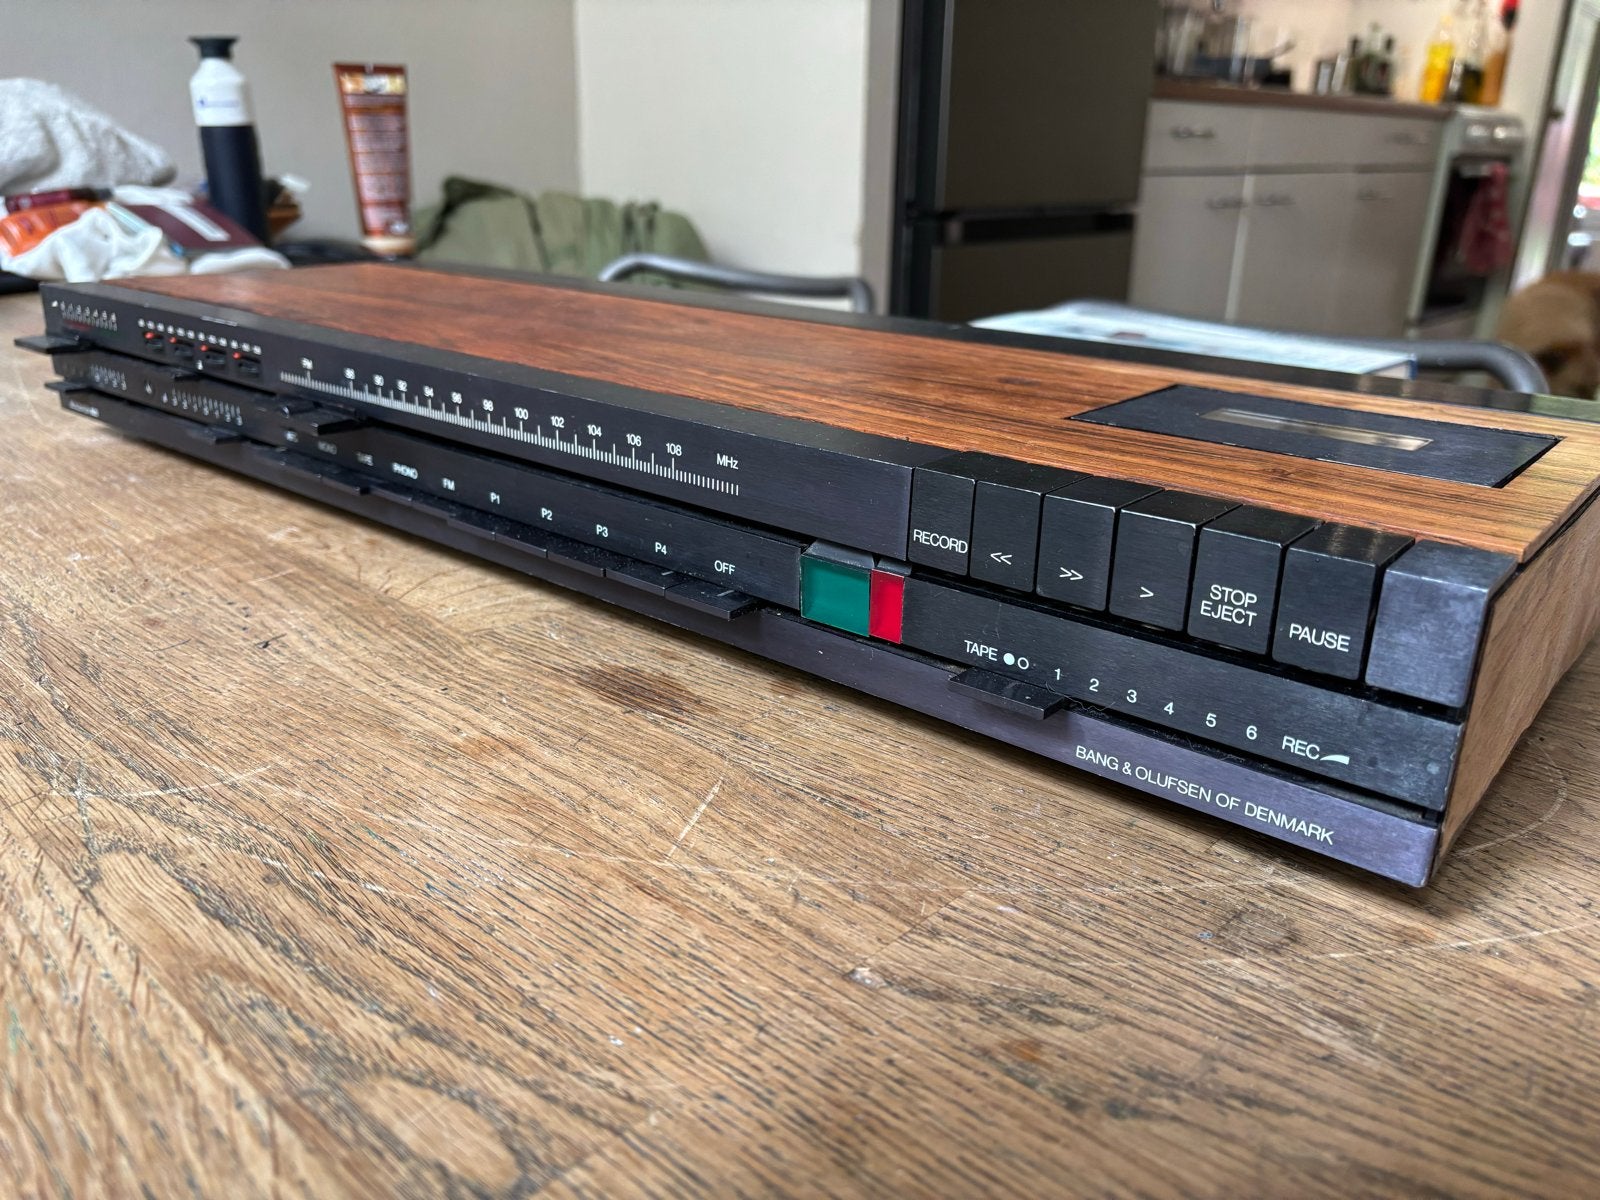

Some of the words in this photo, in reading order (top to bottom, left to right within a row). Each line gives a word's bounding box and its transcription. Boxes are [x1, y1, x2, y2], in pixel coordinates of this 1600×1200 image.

[396, 380, 407, 392] 92
[423, 385, 434, 398] 94
[451, 391, 462, 404] 96
[482, 399, 494, 412] 98
[514, 407, 529, 421] 100
[550, 416, 565, 429] 102
[587, 424, 602, 438] 104
[626, 433, 642, 447] 106
[665, 443, 682, 457] 108
[716, 453, 739, 470] MHz
[391, 462, 418, 480] PHONO
[442, 477, 456, 491] FM
[490, 492, 501, 504] P1
[541, 507, 553, 521] P2
[596, 524, 609, 538] P3
[913, 529, 968, 554] RECORD
[655, 542, 667, 555] P4
[714, 560, 736, 576] OFF
[1209, 584, 1257, 608] STOP
[1200, 600, 1257, 627] EJECT
[1289, 623, 1350, 653] PAUSE
[964, 639, 998, 661] TAPE
[1054, 668, 1061, 681] 1
[1089, 678, 1100, 692] 2
[1126, 689, 1138, 703] 3
[1163, 702, 1174, 715] 4
[1205, 713, 1217, 727] 5
[1246, 725, 1258, 740] 6
[1281, 735, 1320, 760] REC
[1075, 745, 1119, 771] BANG
[1122, 761, 1132, 776] &
[1135, 766, 1212, 803] OLUFSEN
[1215, 793, 1242, 811] OF
[1244, 801, 1335, 846] DENMARK
